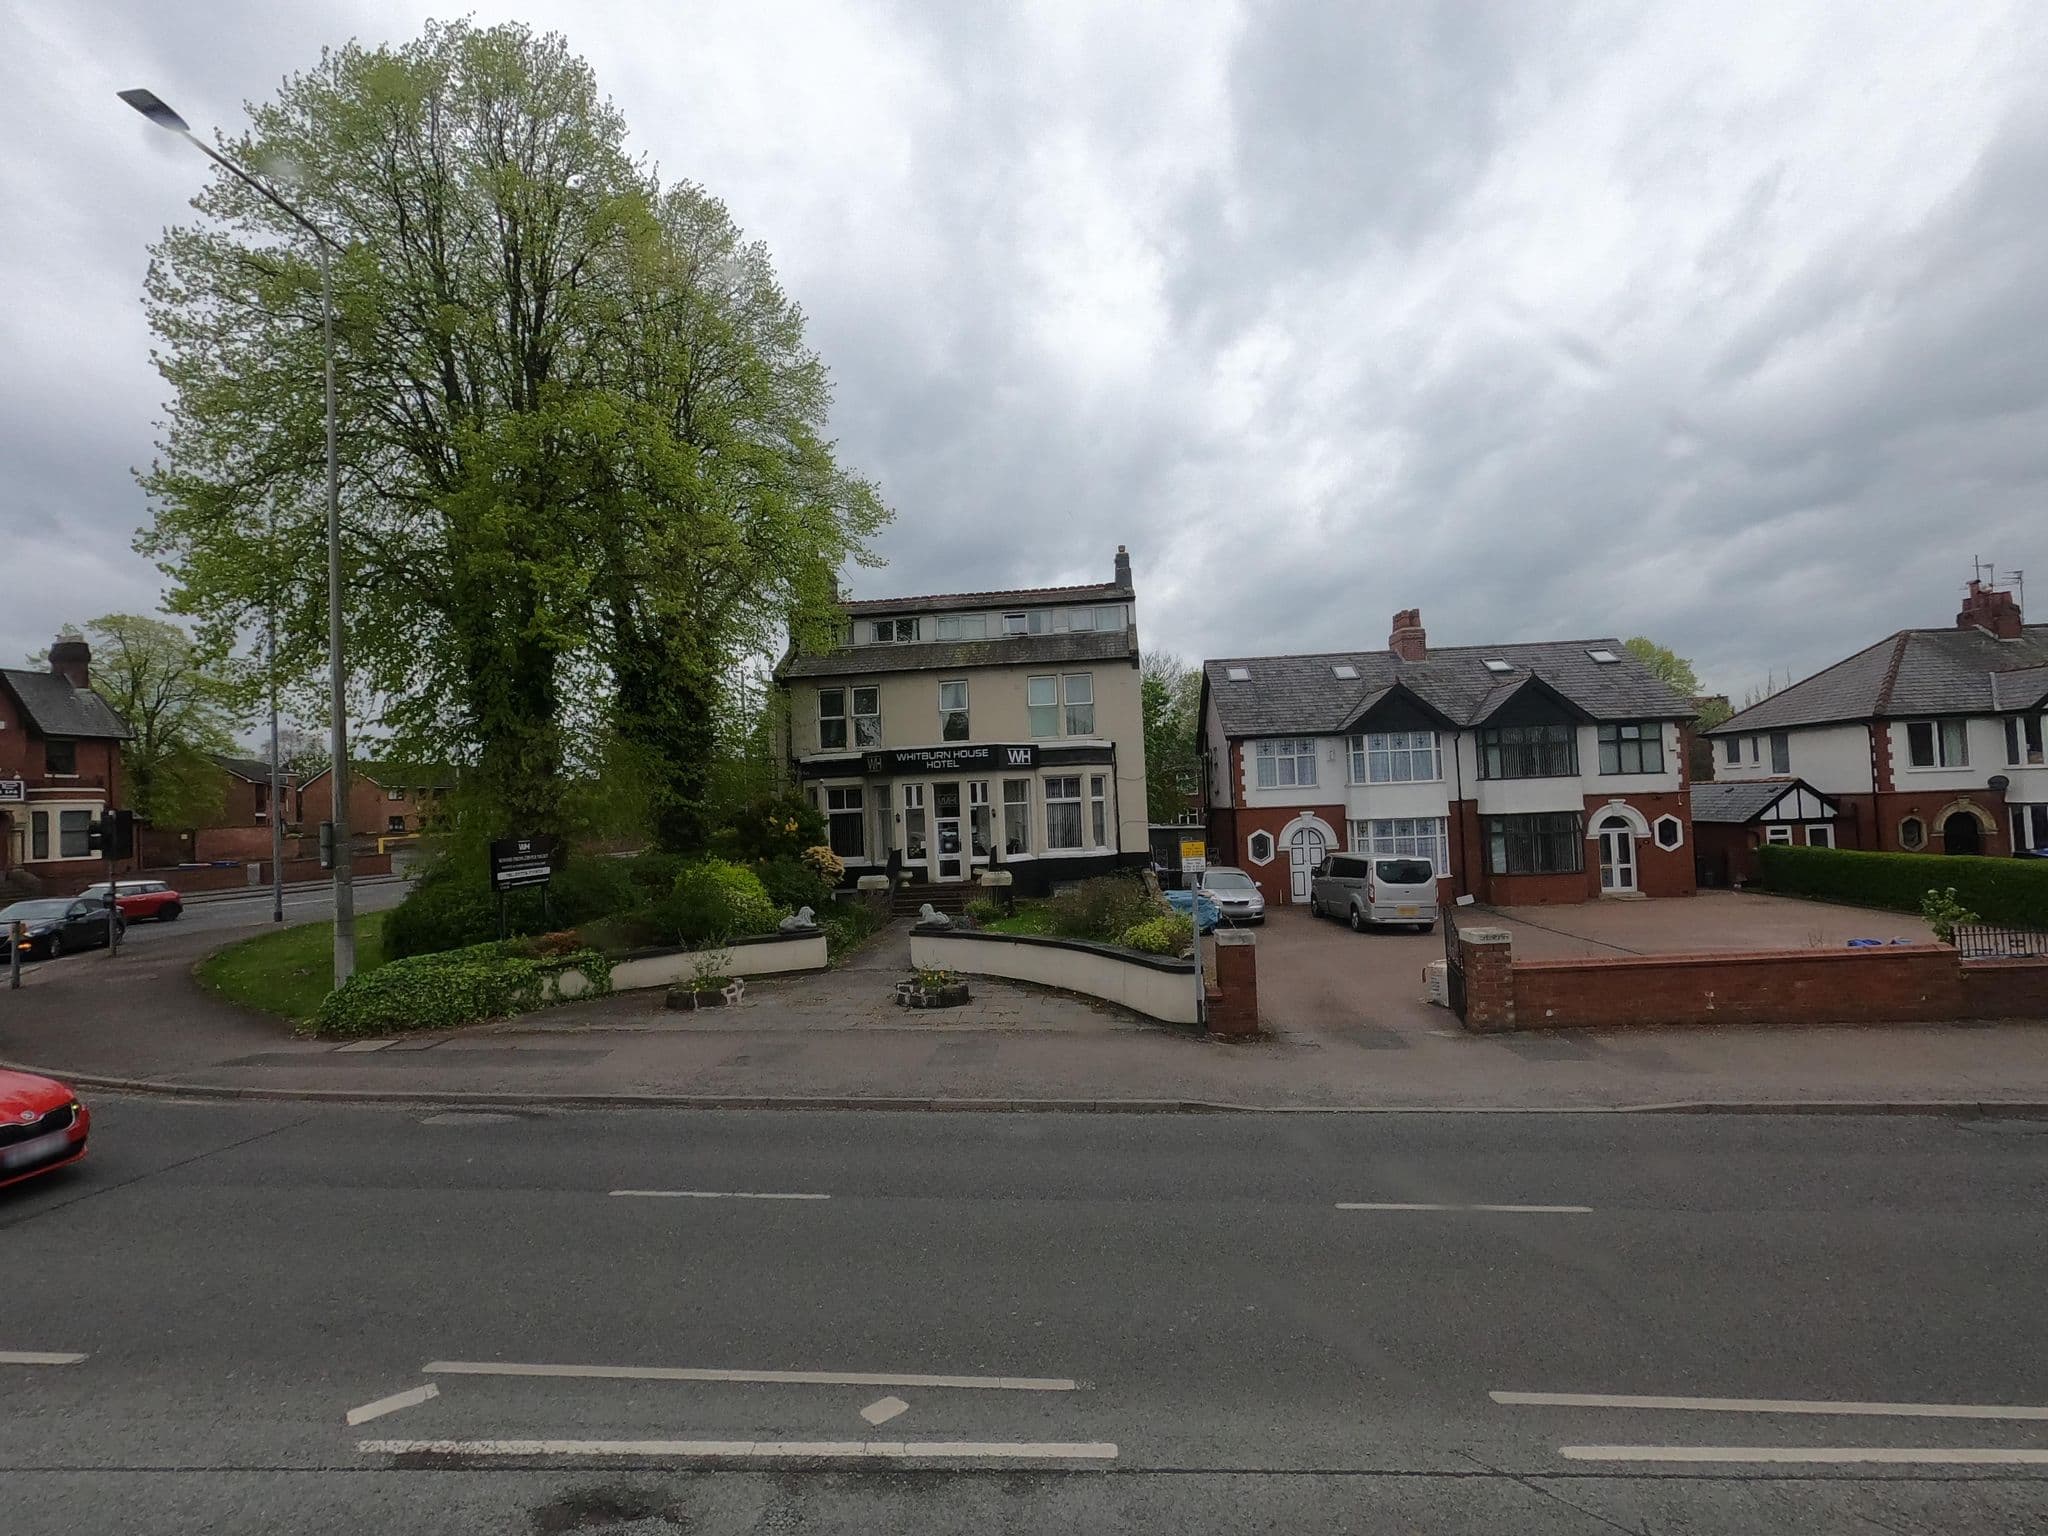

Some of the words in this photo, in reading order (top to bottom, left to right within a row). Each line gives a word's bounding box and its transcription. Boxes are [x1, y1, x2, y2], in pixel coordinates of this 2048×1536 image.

[896, 751, 951, 761] WHITBURN
[953, 749, 989, 759] HOUSE
[1007, 750, 1031, 763] WH
[868, 757, 882, 770] WH
[926, 760, 960, 768] HOTEL
